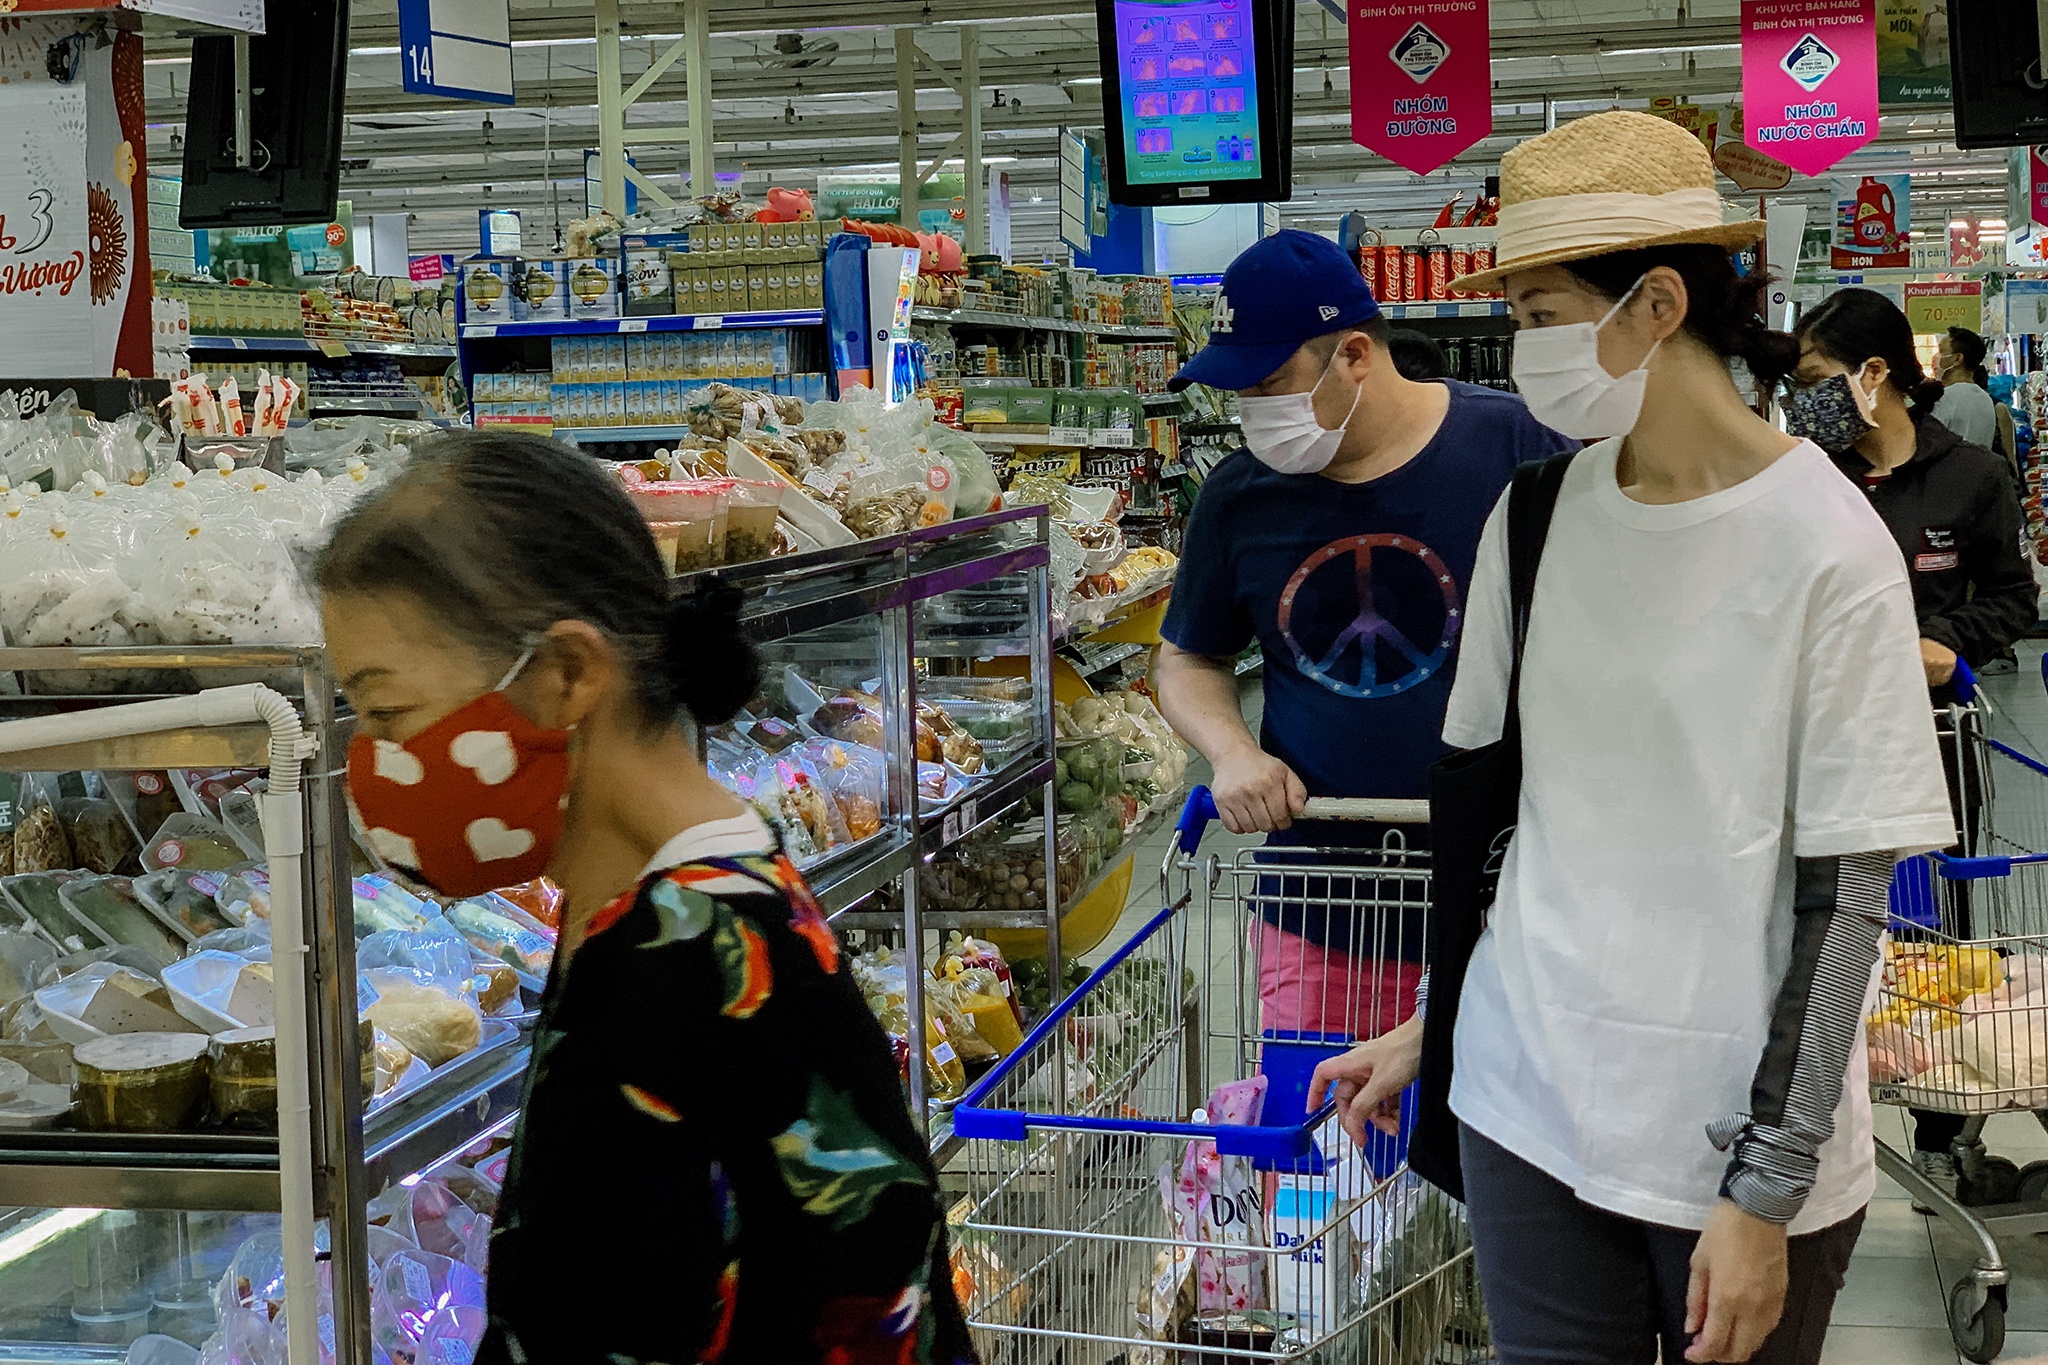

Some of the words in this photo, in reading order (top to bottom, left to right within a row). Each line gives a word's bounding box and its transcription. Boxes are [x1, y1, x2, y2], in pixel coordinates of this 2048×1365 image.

[1756, 6, 1778, 14] KHU
[1753, 19, 1778, 30] BÌNH
[1798, 18, 1815, 28] THỊ
[1817, 14, 1864, 26] TRƯỜNG
[409, 44, 431, 84] 14
[1394, 94, 1447, 114] NHÓM
[1786, 101, 1837, 120] NHÓM
[1386, 117, 1456, 137] ĐƯỜNG
[1758, 121, 1811, 142] NƯỚC
[1815, 116, 1865, 138] CHẤM
[1851, 256, 1873, 266] HON
[3, 250, 84, 296] Vượng
[1212, 286, 1234, 333] LA
